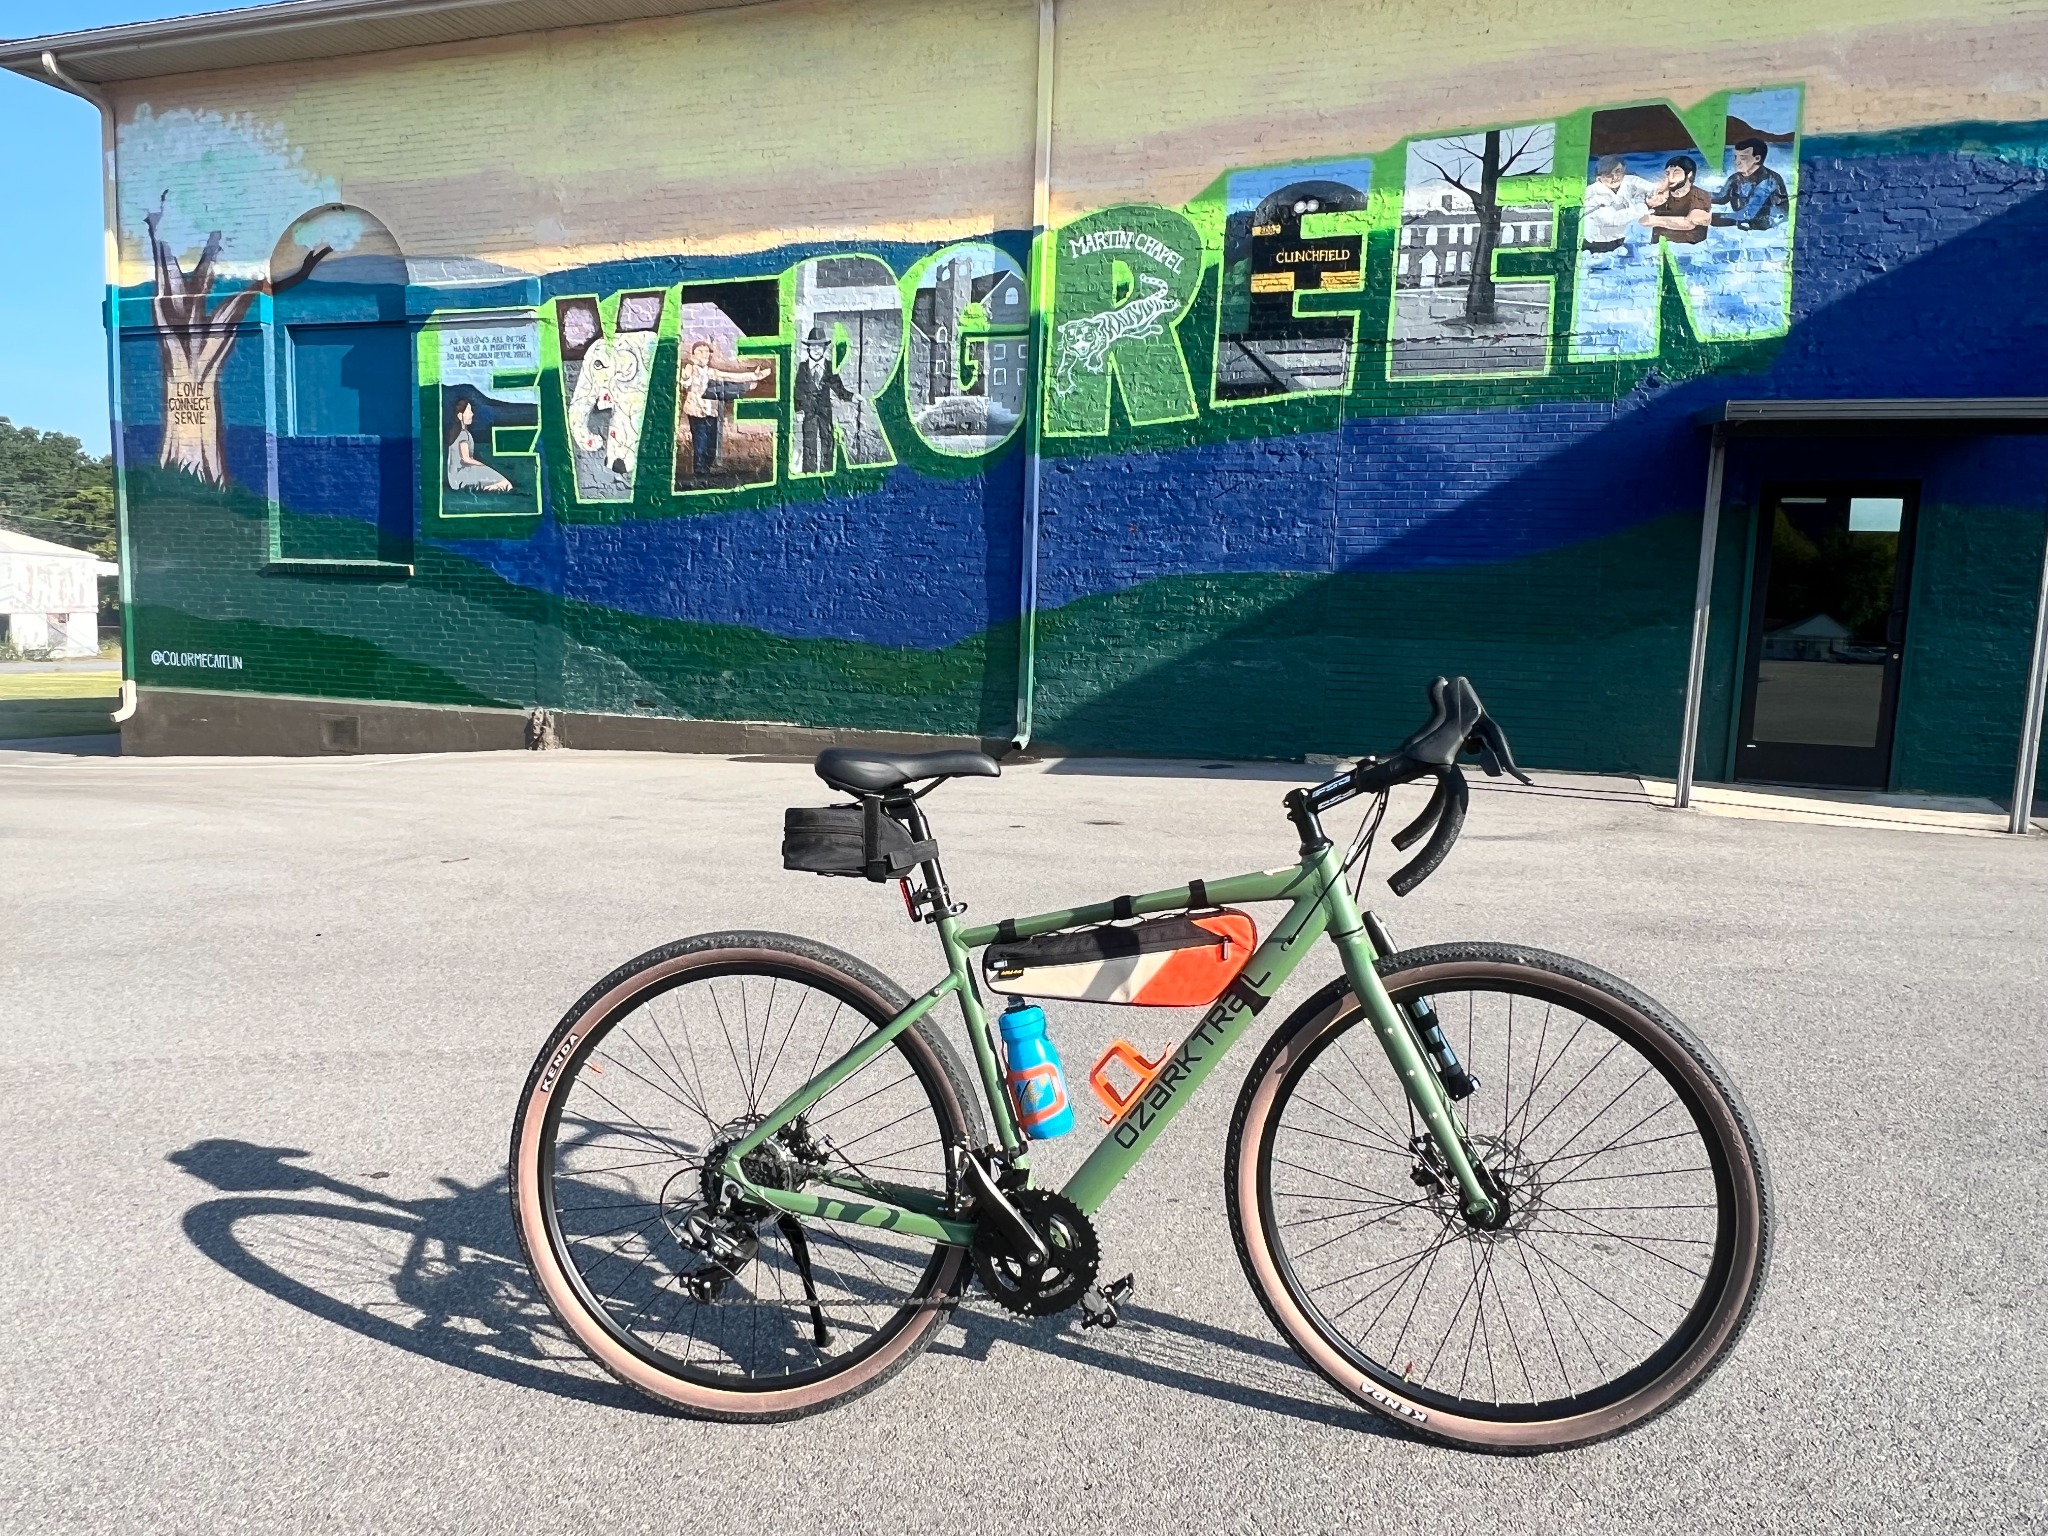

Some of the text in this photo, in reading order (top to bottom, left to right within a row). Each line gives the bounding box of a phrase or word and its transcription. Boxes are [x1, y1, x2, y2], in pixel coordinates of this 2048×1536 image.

[1069, 230, 1185, 275] MARTIN CHAPEL
[1276, 249, 1350, 264] CLINCHFIELD
[420, 84, 1804, 518] EVERGREEN
[453, 344, 471, 352] HAND
[482, 344, 488, 352] A
[176, 381, 204, 397] LOVE
[168, 397, 211, 411] CONNECT
[174, 411, 206, 425] SERVE
[150, 650, 243, 669] @COLORMECAITLIN
[541, 1033, 580, 1093] KENDA
[1360, 1381, 1428, 1423] KENDA
